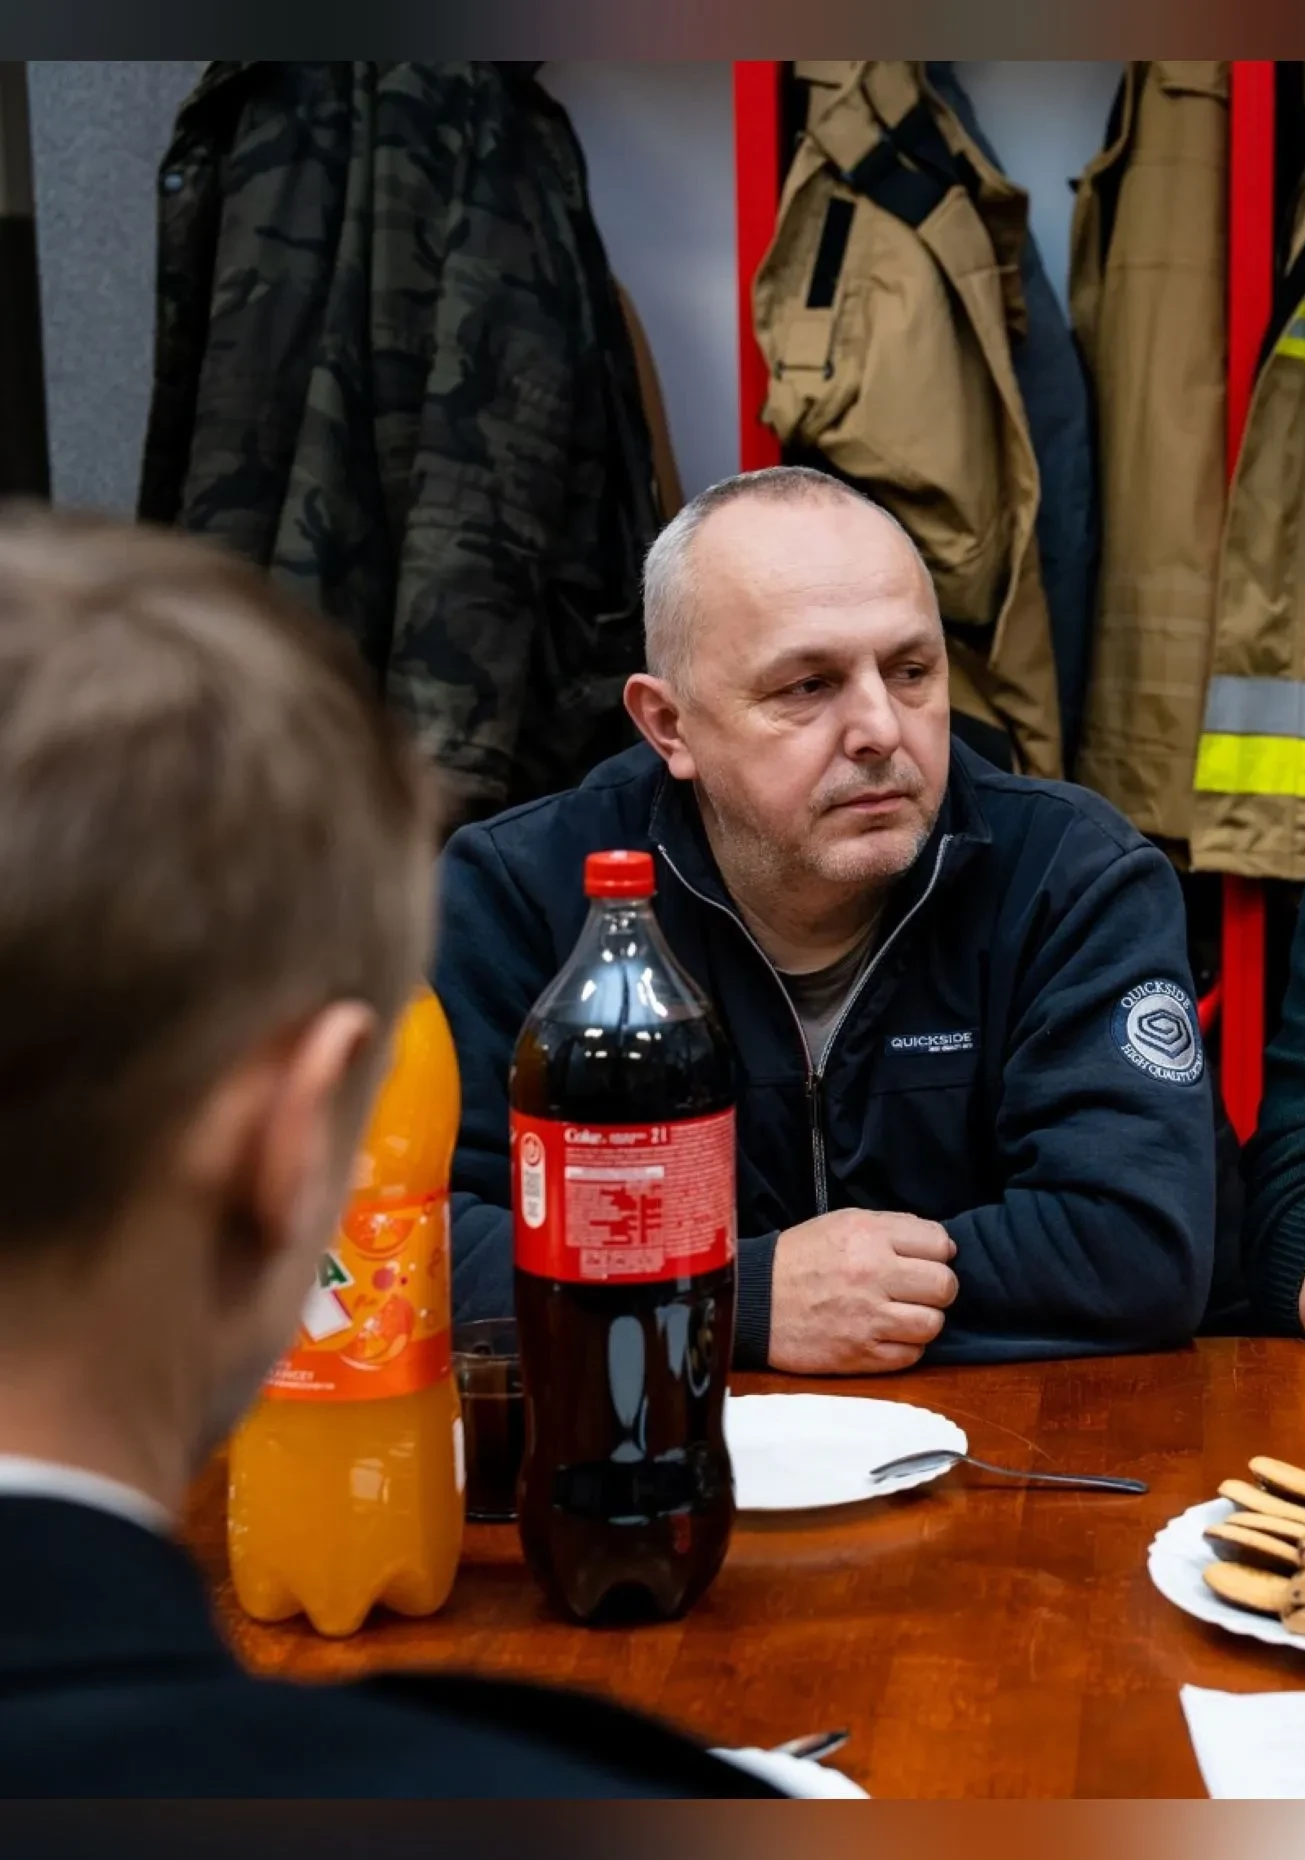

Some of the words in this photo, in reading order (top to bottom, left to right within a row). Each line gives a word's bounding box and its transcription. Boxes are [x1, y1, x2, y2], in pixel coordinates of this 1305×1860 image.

[1120, 981, 1191, 1010] QUICKSIDE
[890, 1032, 973, 1049] QUICKSIDE
[1120, 1042, 1150, 1069] HIGH
